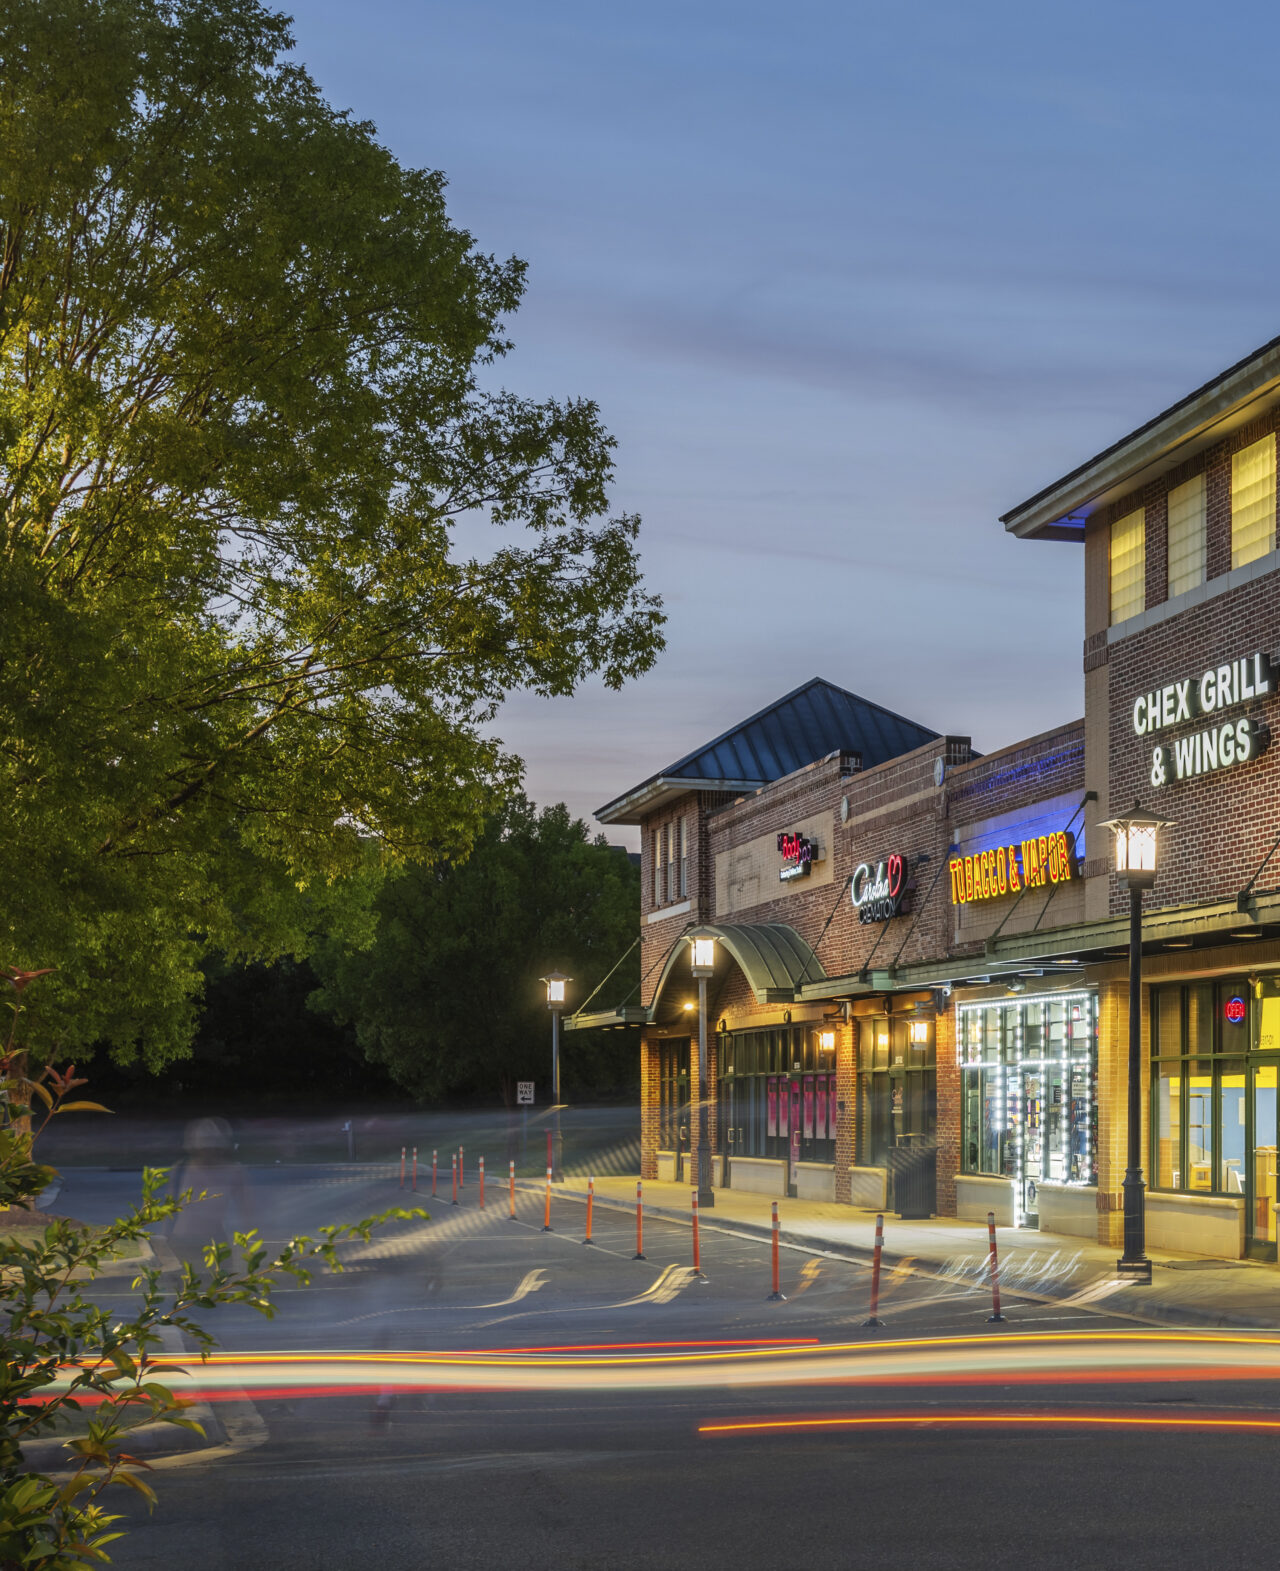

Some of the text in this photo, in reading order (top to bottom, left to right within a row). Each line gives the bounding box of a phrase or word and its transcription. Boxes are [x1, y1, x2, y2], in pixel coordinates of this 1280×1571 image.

[1133, 653, 1269, 736] CHEX GRILL
[1151, 718, 1251, 787] & WINGS
[949, 831, 1071, 905] TOBACCO & VAPOR
[1227, 1002, 1245, 1018] OPEN
